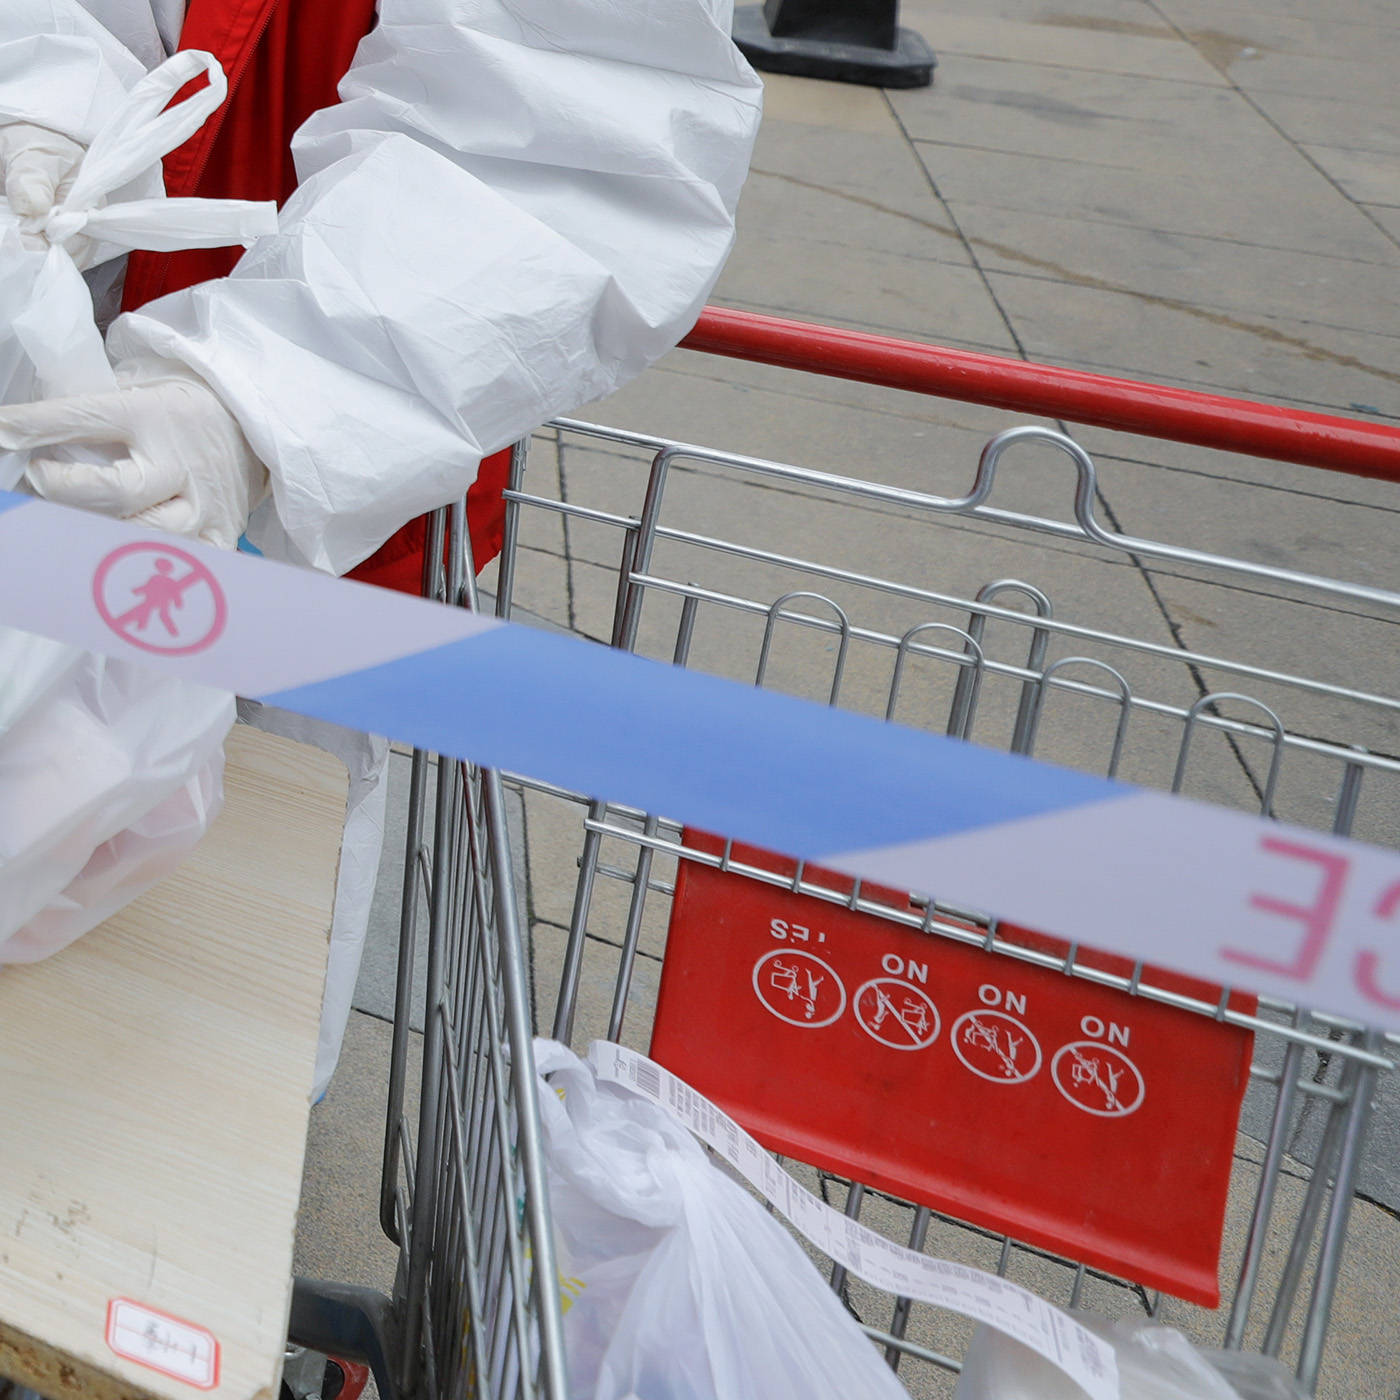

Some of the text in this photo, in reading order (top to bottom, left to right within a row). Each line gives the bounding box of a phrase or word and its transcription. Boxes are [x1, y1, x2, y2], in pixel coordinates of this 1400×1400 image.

[881, 952, 929, 984] NO
[978, 984, 1027, 1015] NO
[1080, 1015, 1131, 1047] NO
